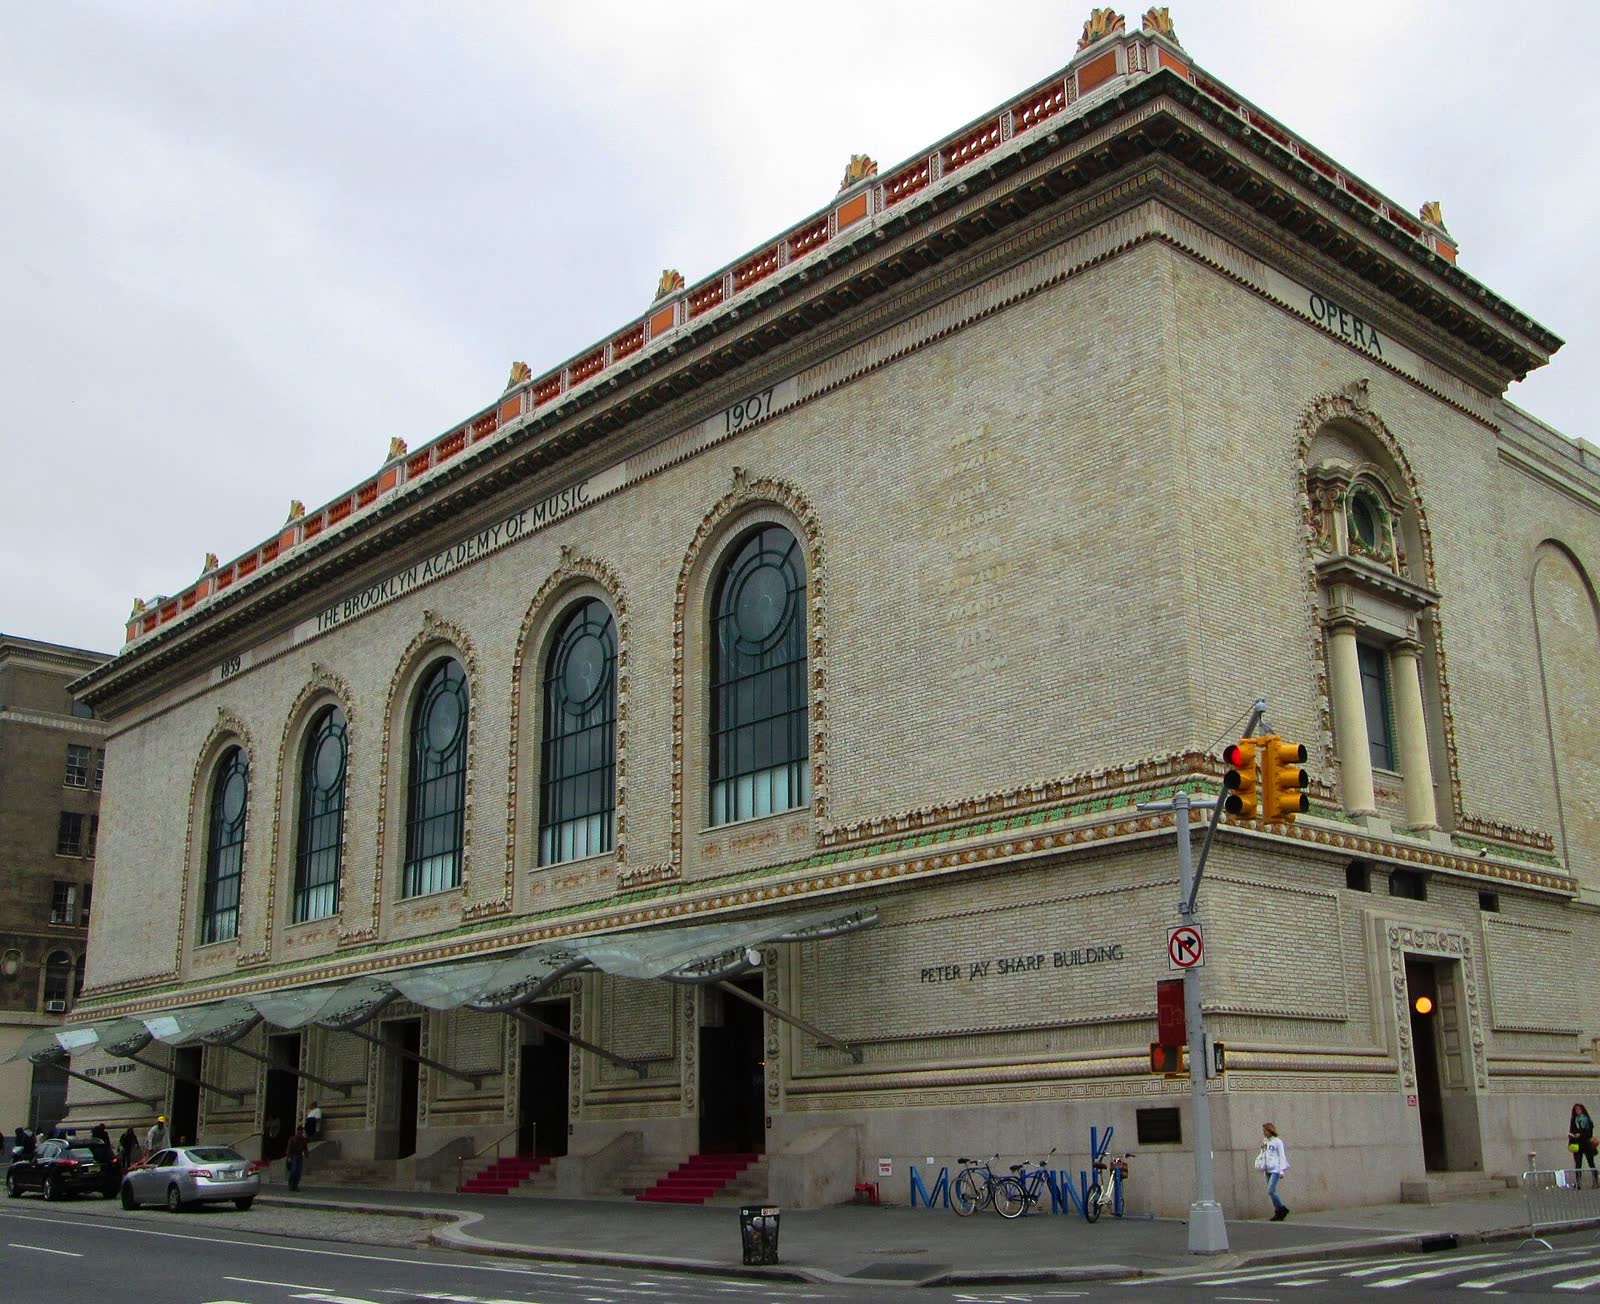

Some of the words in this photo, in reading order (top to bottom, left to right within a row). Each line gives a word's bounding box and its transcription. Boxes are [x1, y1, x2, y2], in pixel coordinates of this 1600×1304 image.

[1309, 292, 1382, 356] OPERA
[725, 387, 775, 433] 1907
[316, 603, 341, 631] THE
[343, 567, 417, 617] BROOKLYN
[422, 524, 502, 580] ACADEMY
[506, 511, 527, 538] OF
[533, 481, 589, 526] MUSIC
[221, 655, 241, 679] 1859
[920, 965, 962, 983] PETER
[969, 961, 991, 981] JAY
[997, 954, 1045, 974] SHARP
[1053, 945, 1124, 968] BUILDING
